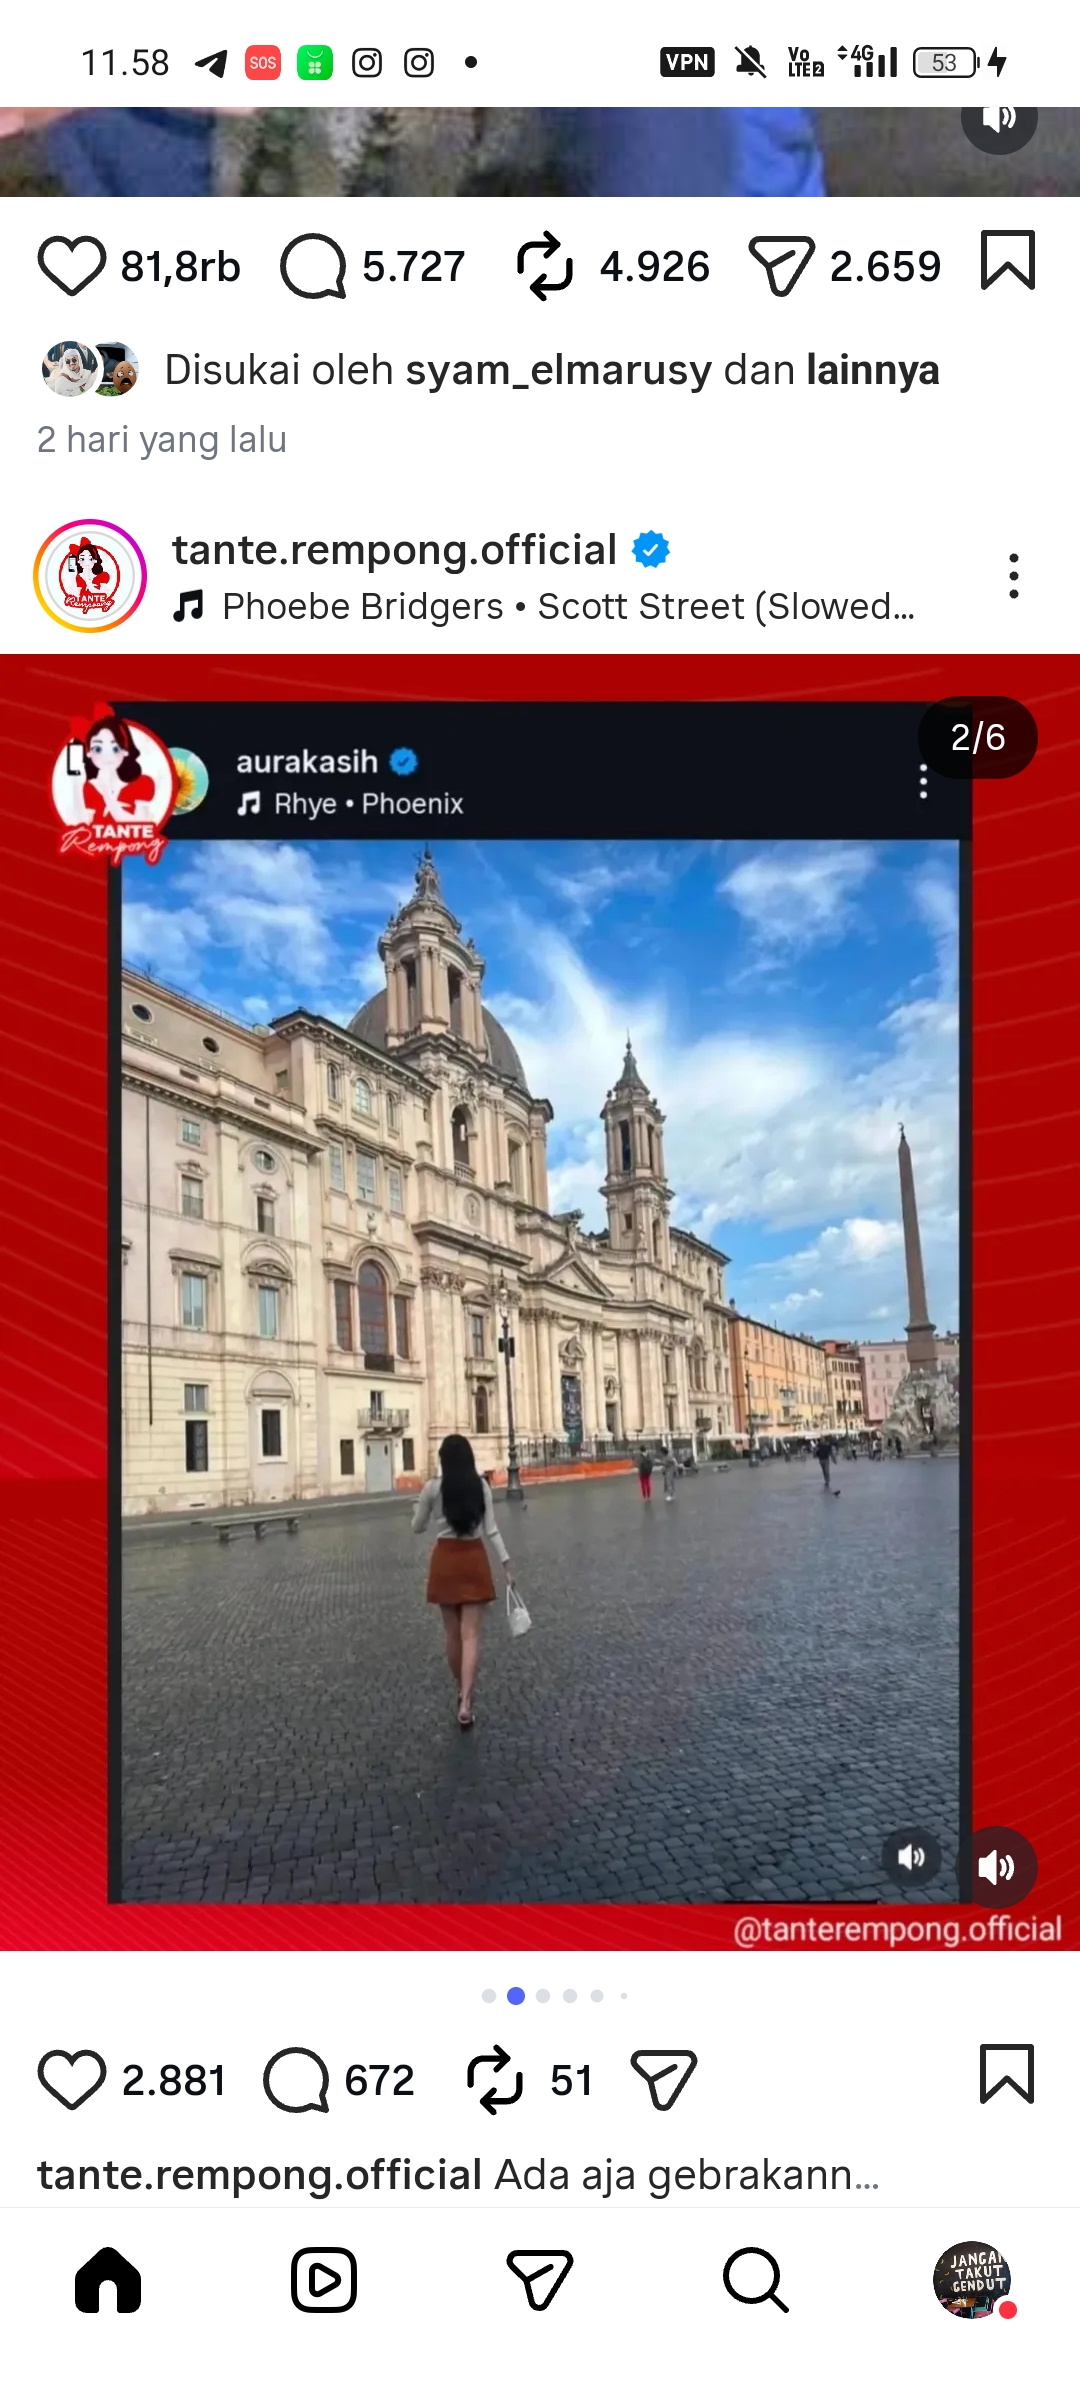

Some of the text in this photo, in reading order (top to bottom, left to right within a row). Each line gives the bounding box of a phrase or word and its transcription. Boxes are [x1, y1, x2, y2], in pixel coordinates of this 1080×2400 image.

[83, 49, 168, 75] 11.58
[250, 56, 276, 69] SOS
[666, 54, 708, 70] VPN
[788, 47, 809, 61] Vo
[851, 45, 873, 60] 4G
[932, 54, 957, 72] 53
[789, 62, 810, 77] LTE
[122, 250, 240, 287] 81,8rb
[364, 250, 465, 282] 5.727
[601, 250, 709, 282] 4.926
[831, 250, 940, 282] 2.659
[167, 352, 939, 393] Disukai oleh syam_elmarusy dan lainnya
[38, 425, 285, 460] 2 hari yang lalu
[172, 533, 615, 574] tante.rempong.official
[225, 592, 349, 619] Phoebe
[363, 592, 503, 627] Bridgers
[539, 593, 627, 619] Scott
[640, 593, 744, 619] Street
[952, 721, 1005, 754] 2/6
[237, 749, 377, 773] aurakasih
[275, 791, 464, 822] Rhye Phoenix
[123, 2064, 226, 2096] 2.881
[346, 2064, 414, 2096] 672
[552, 2065, 592, 2096] 51
[37, 2158, 480, 2199] tante.rempong.official
[494, 2158, 568, 2190] Ada
[583, 2158, 634, 2198] aja
[953, 2278, 1006, 2292] GENDUT
[955, 2265, 1003, 2280] TAKUT
